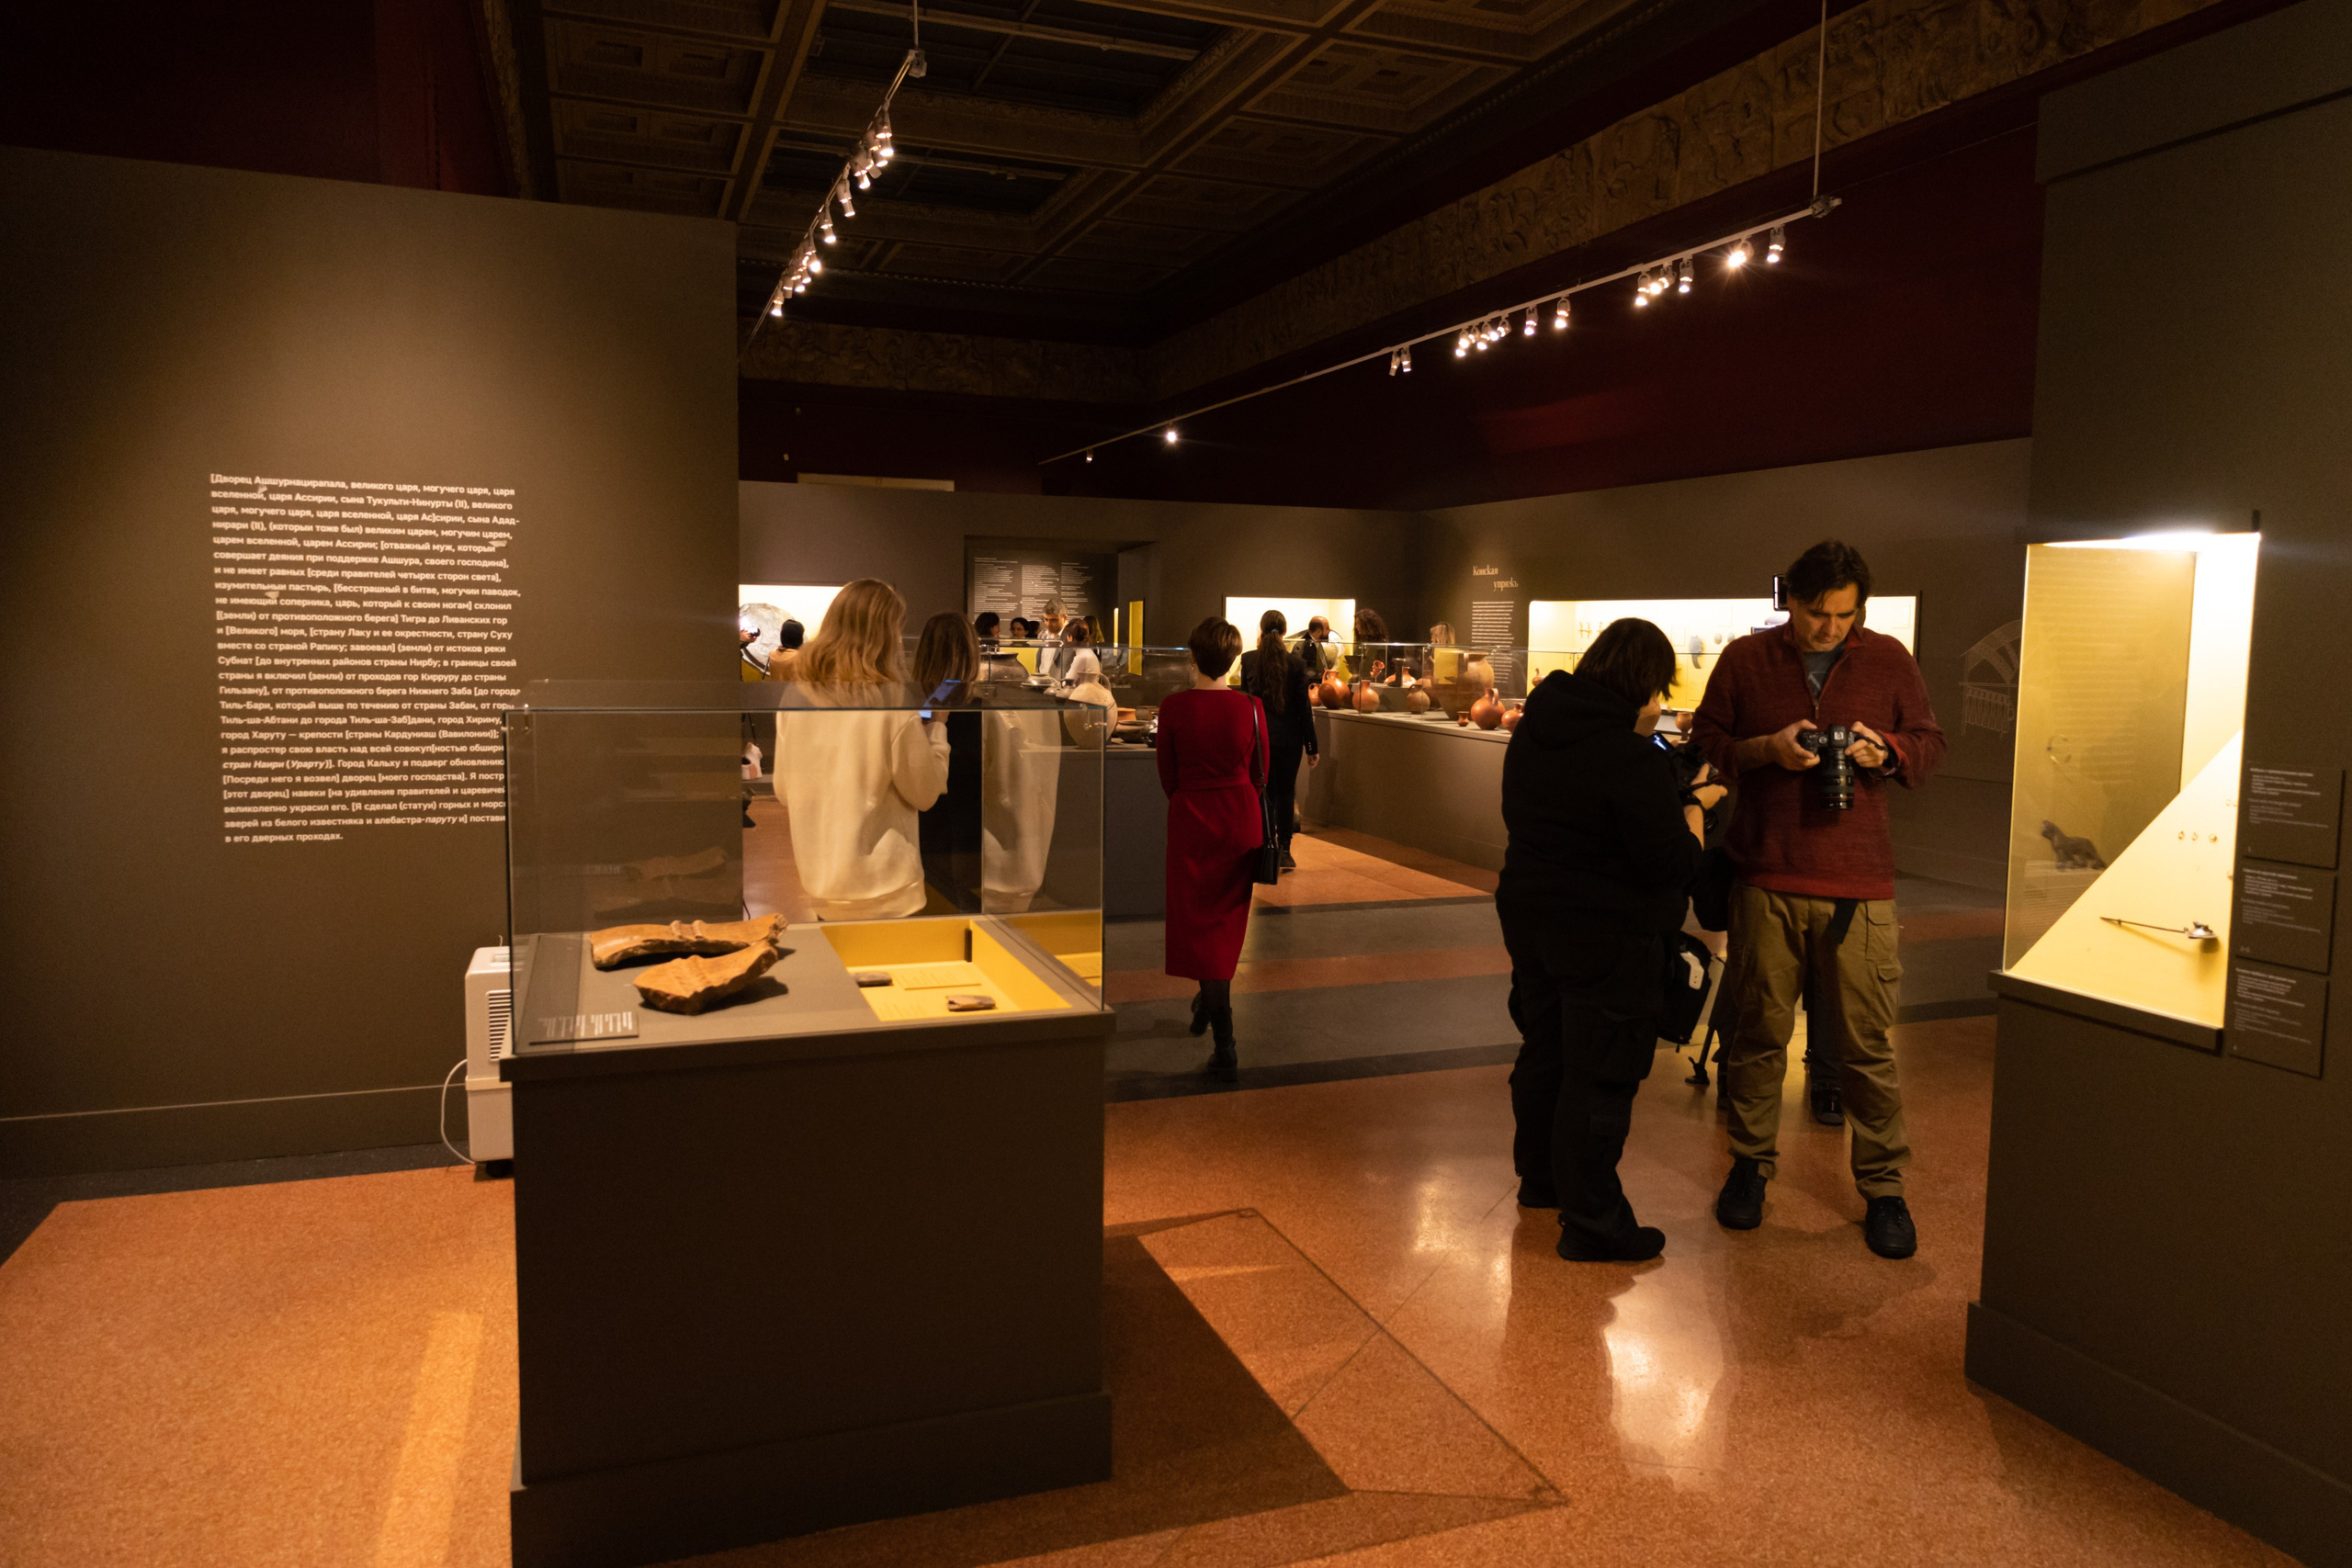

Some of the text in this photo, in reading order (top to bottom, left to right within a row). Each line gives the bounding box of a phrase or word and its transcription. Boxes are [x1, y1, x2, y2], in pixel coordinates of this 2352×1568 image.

[254, 476, 348, 490] Ашшурнацирапала,
[350, 481, 393, 490] великого
[395, 484, 420, 492] царя,
[423, 485, 464, 494] могучего
[467, 487, 491, 495] царя,
[268, 493, 292, 502] царя
[294, 492, 338, 503] Ассирии,
[211, 506, 238, 514] царя,
[241, 507, 286, 516] могучего
[288, 509, 313, 517] царя,
[316, 510, 339, 518] царя
[342, 510, 393, 520] вселенной,
[396, 513, 418, 522] царя
[492, 515, 519, 525] Адад-
[212, 522, 248, 530] нирари
[407, 528, 438, 536] царем,
[441, 529, 480, 538] могучим
[481, 531, 512, 539] царем,
[212, 536, 243, 545] царем
[246, 536, 300, 547] вселенной,
[303, 539, 333, 548] царем
[432, 544, 455, 552] муж,
[213, 551, 266, 560] совершает
[268, 553, 303, 561] деяния
[325, 555, 379, 564] поддержке
[380, 556, 422, 566] Ашшура,
[269, 569, 305, 577] равных
[341, 570, 395, 580] правителей
[397, 572, 435, 581] четырех
[437, 573, 469, 581] сторон
[288, 584, 331, 592] пастырь,
[410, 585, 438, 594] битве,
[279, 599, 332, 607] соперника,
[335, 600, 360, 608] царь,
[363, 599, 401, 608] который
[272, 614, 362, 622] противоположного
[400, 615, 426, 624] Тигра
[280, 628, 307, 637] моря,
[347, 628, 371, 637] Лаку
[394, 630, 455, 638] окрестности,
[457, 631, 488, 639] страну
[490, 630, 512, 639] Суху
[268, 642, 307, 651] страной
[218, 656, 253, 665] Субнат
[274, 658, 330, 666] внутренних
[333, 658, 371, 666] районов
[450, 660, 488, 668] границы
[376, 686, 406, 695] берега
[220, 701, 273, 710] Тиль-Бари,
[276, 701, 315, 710] который
[466, 716, 502, 724] Хириму,
[252, 730, 286, 739] Харуту
[384, 730, 435, 739] Кардуниаш
[222, 761, 251, 770] стран
[337, 759, 365, 768] Город
[367, 759, 400, 768] Кальху
[345, 789, 394, 797] удивление
[397, 786, 450, 796] правителей
[289, 805, 328, 813] украсил
[224, 819, 258, 829] зверей
[274, 818, 307, 826] белого
[252, 834, 293, 842] дверных
[296, 833, 343, 841] проходах.
